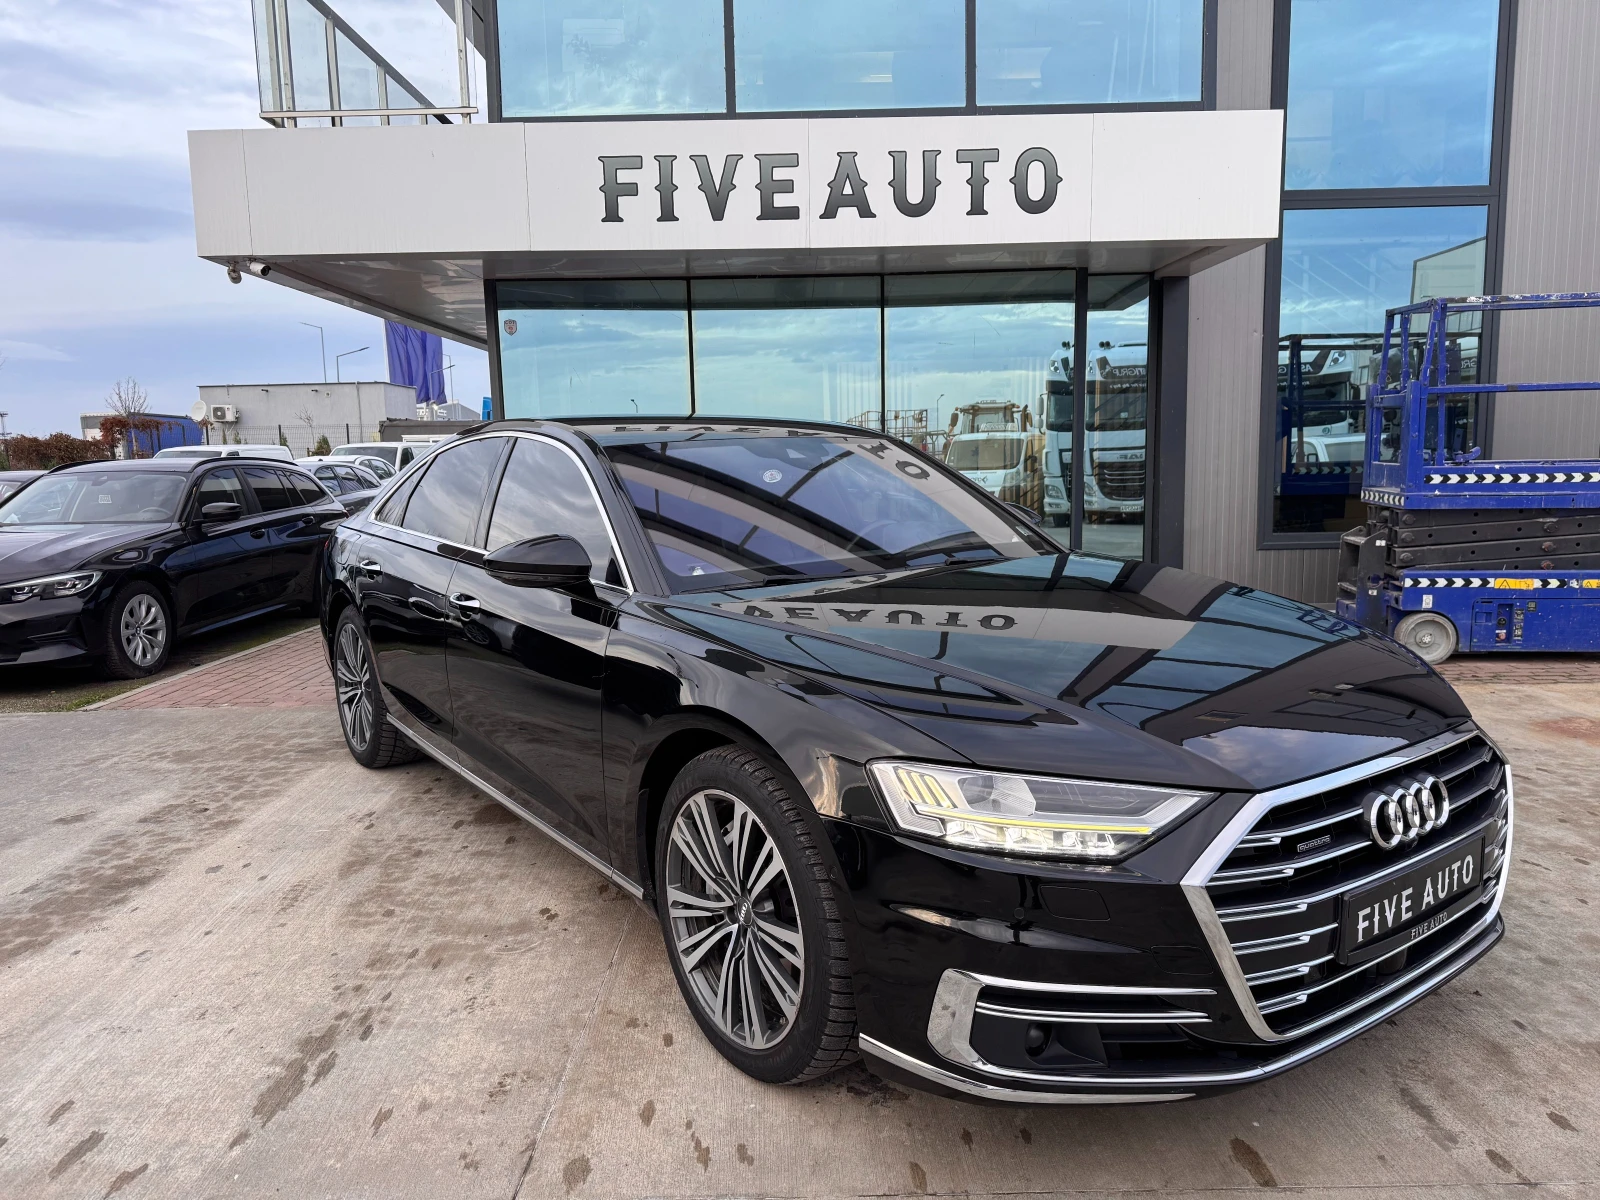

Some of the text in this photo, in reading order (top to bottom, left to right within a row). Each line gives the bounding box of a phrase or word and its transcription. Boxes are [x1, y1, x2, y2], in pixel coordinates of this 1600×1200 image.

[598, 146, 1064, 222] FIVE AUTO
[1299, 837, 1331, 850] quattro
[1357, 854, 1474, 943] FIVE AUTO
[1411, 911, 1448, 940] FIVE AUTO
